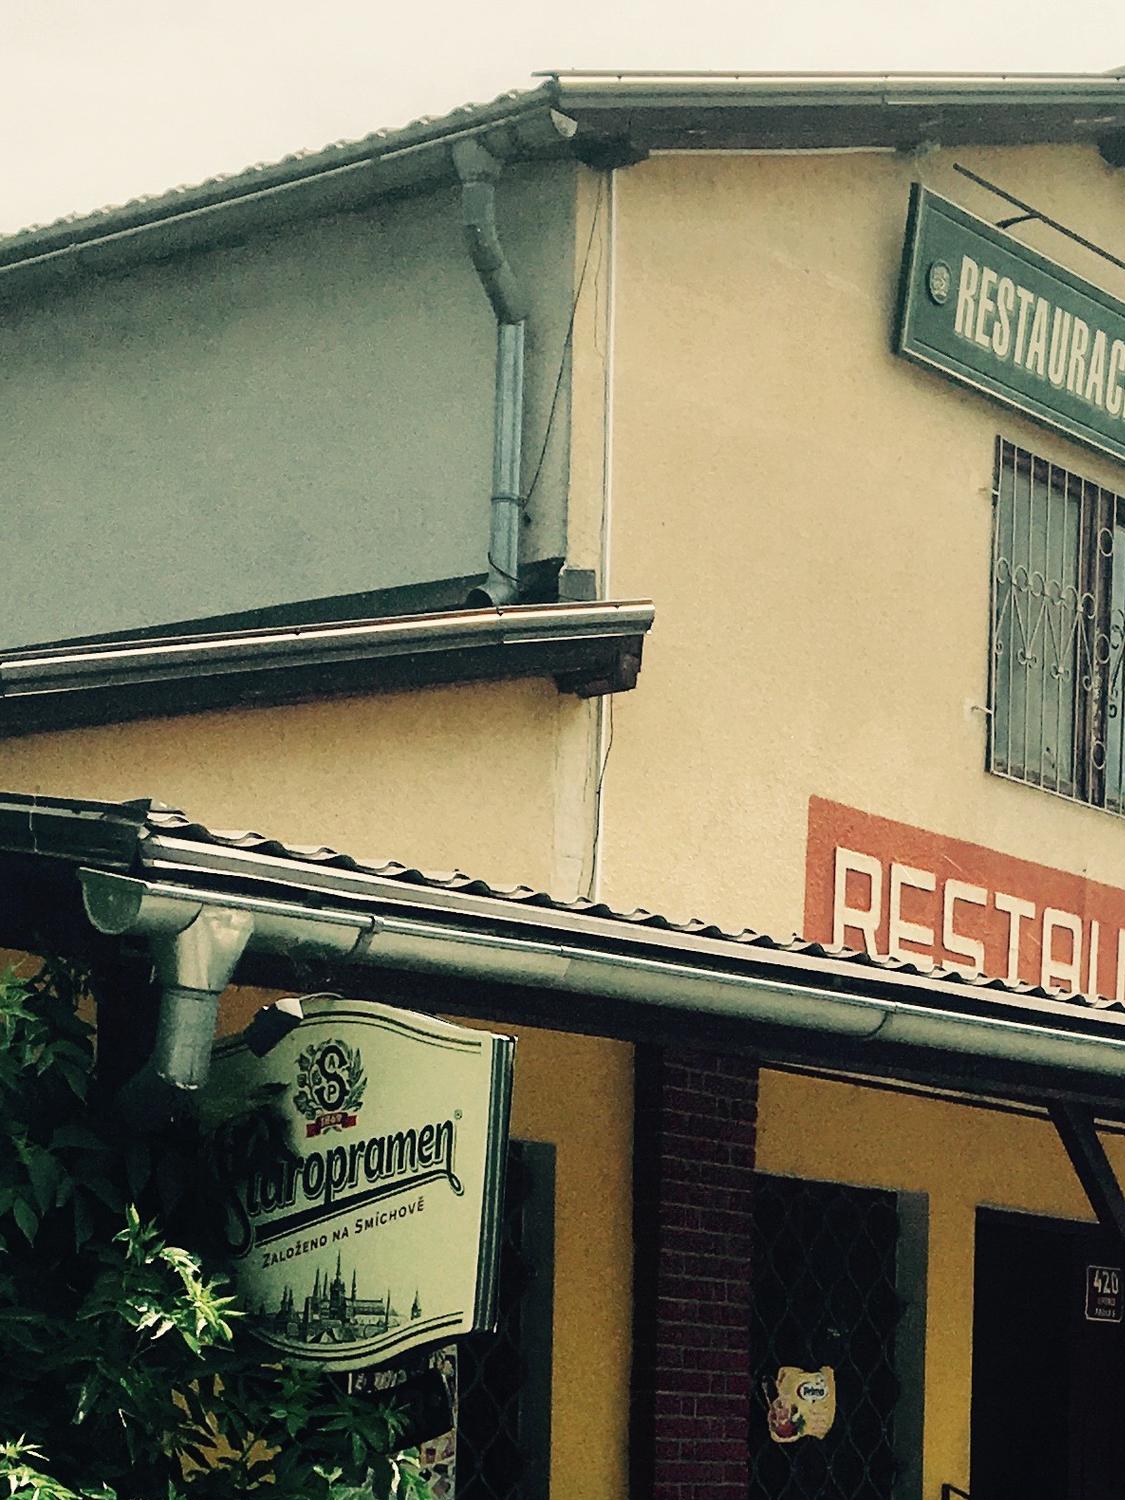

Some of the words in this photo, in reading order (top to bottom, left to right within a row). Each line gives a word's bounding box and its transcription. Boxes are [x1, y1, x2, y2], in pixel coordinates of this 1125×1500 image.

[262, 1239, 327, 1269] ZALOŽENO
[332, 1226, 349, 1243] NA
[355, 1196, 425, 1234] SMÍCHOVĚ
[1093, 1269, 1119, 1294] 420
